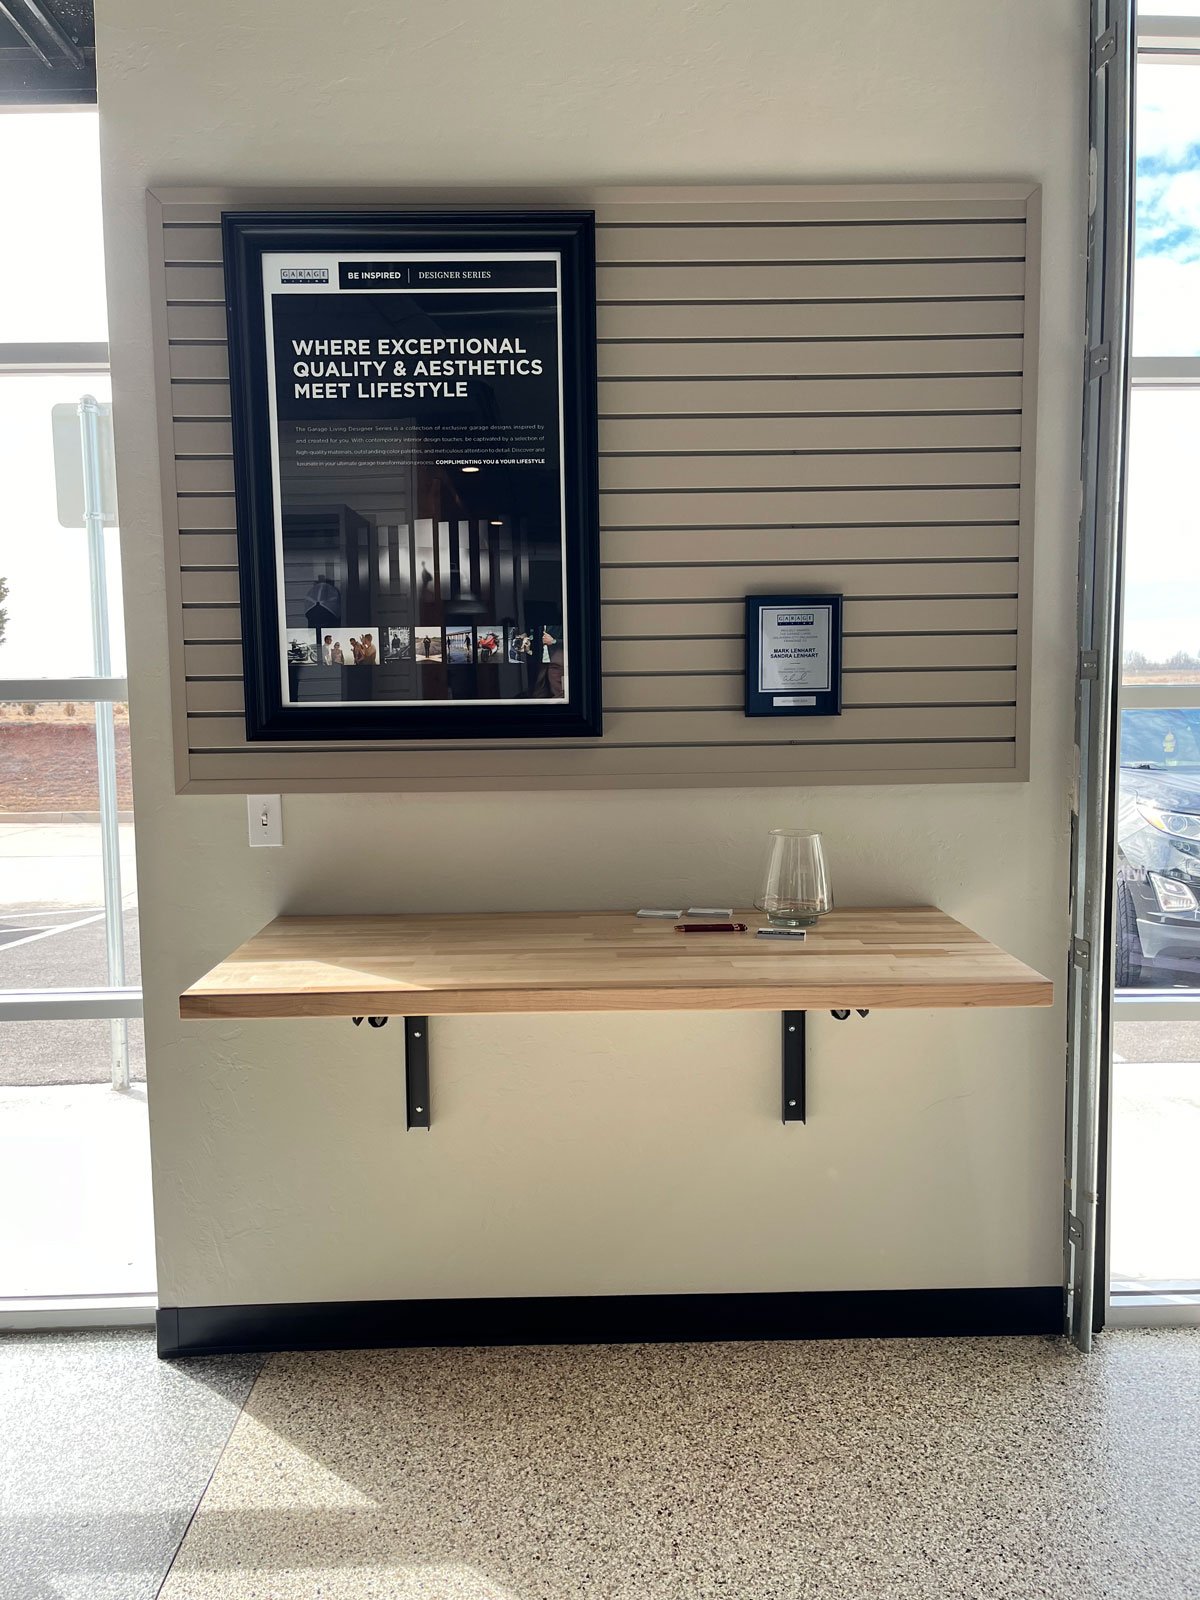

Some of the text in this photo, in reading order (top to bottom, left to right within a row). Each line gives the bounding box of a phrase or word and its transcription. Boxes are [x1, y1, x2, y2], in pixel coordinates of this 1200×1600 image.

[292, 338, 527, 356] WHERE EXCEPTIONAL
[293, 359, 543, 378] QUALITY & AESTHETICS
[295, 381, 468, 399] MEET LIFESTYLE
